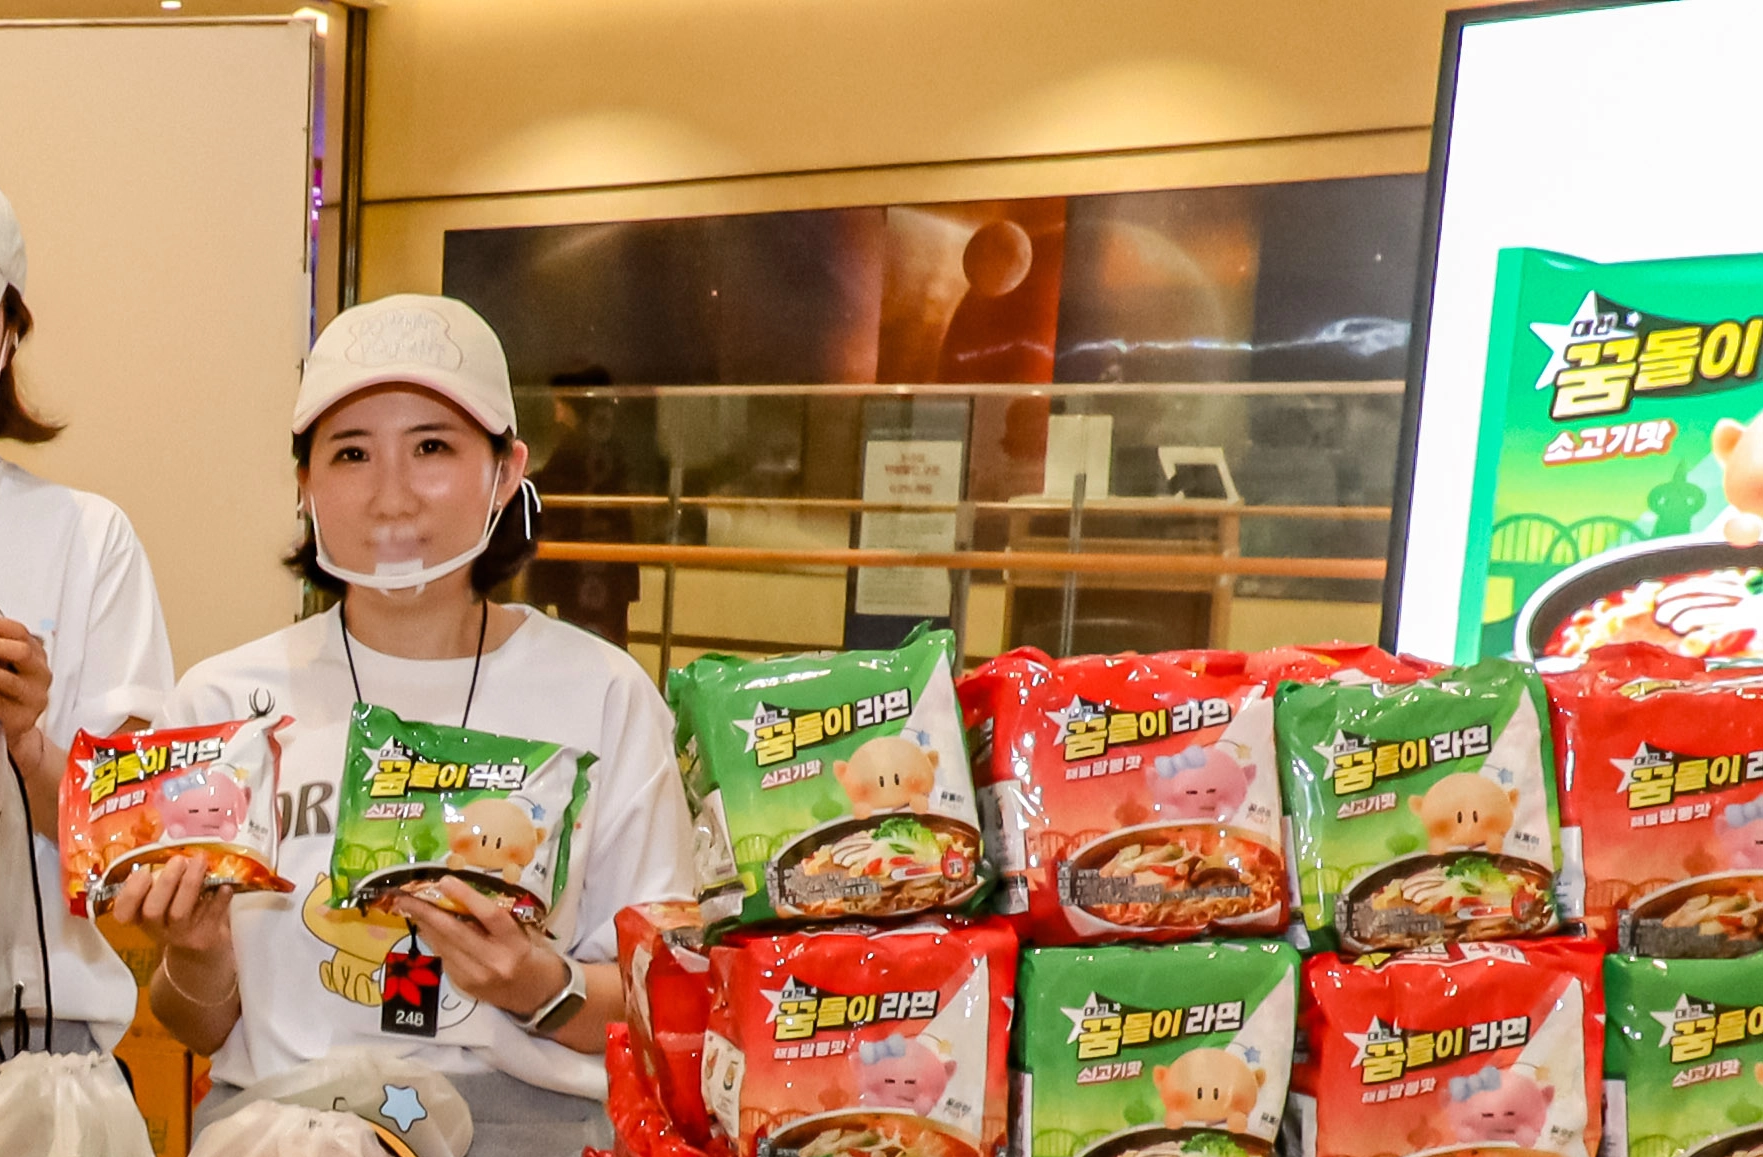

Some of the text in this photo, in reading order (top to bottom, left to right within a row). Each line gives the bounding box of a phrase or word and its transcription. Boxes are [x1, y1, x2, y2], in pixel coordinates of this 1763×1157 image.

[756, 688, 911, 766] 꿈돌이 라면
[1064, 699, 1231, 761] 꿈돌이 라면
[1333, 724, 1491, 795] 꿈돌이 라면
[1628, 754, 1744, 809] 꿈돌이
[395, 1009, 425, 1027] 248
[774, 990, 939, 1041] 꿈돌이 라면
[1077, 1001, 1245, 1061] 꿈돌이 라면
[1361, 1016, 1530, 1084] 꿈돌이 라면
